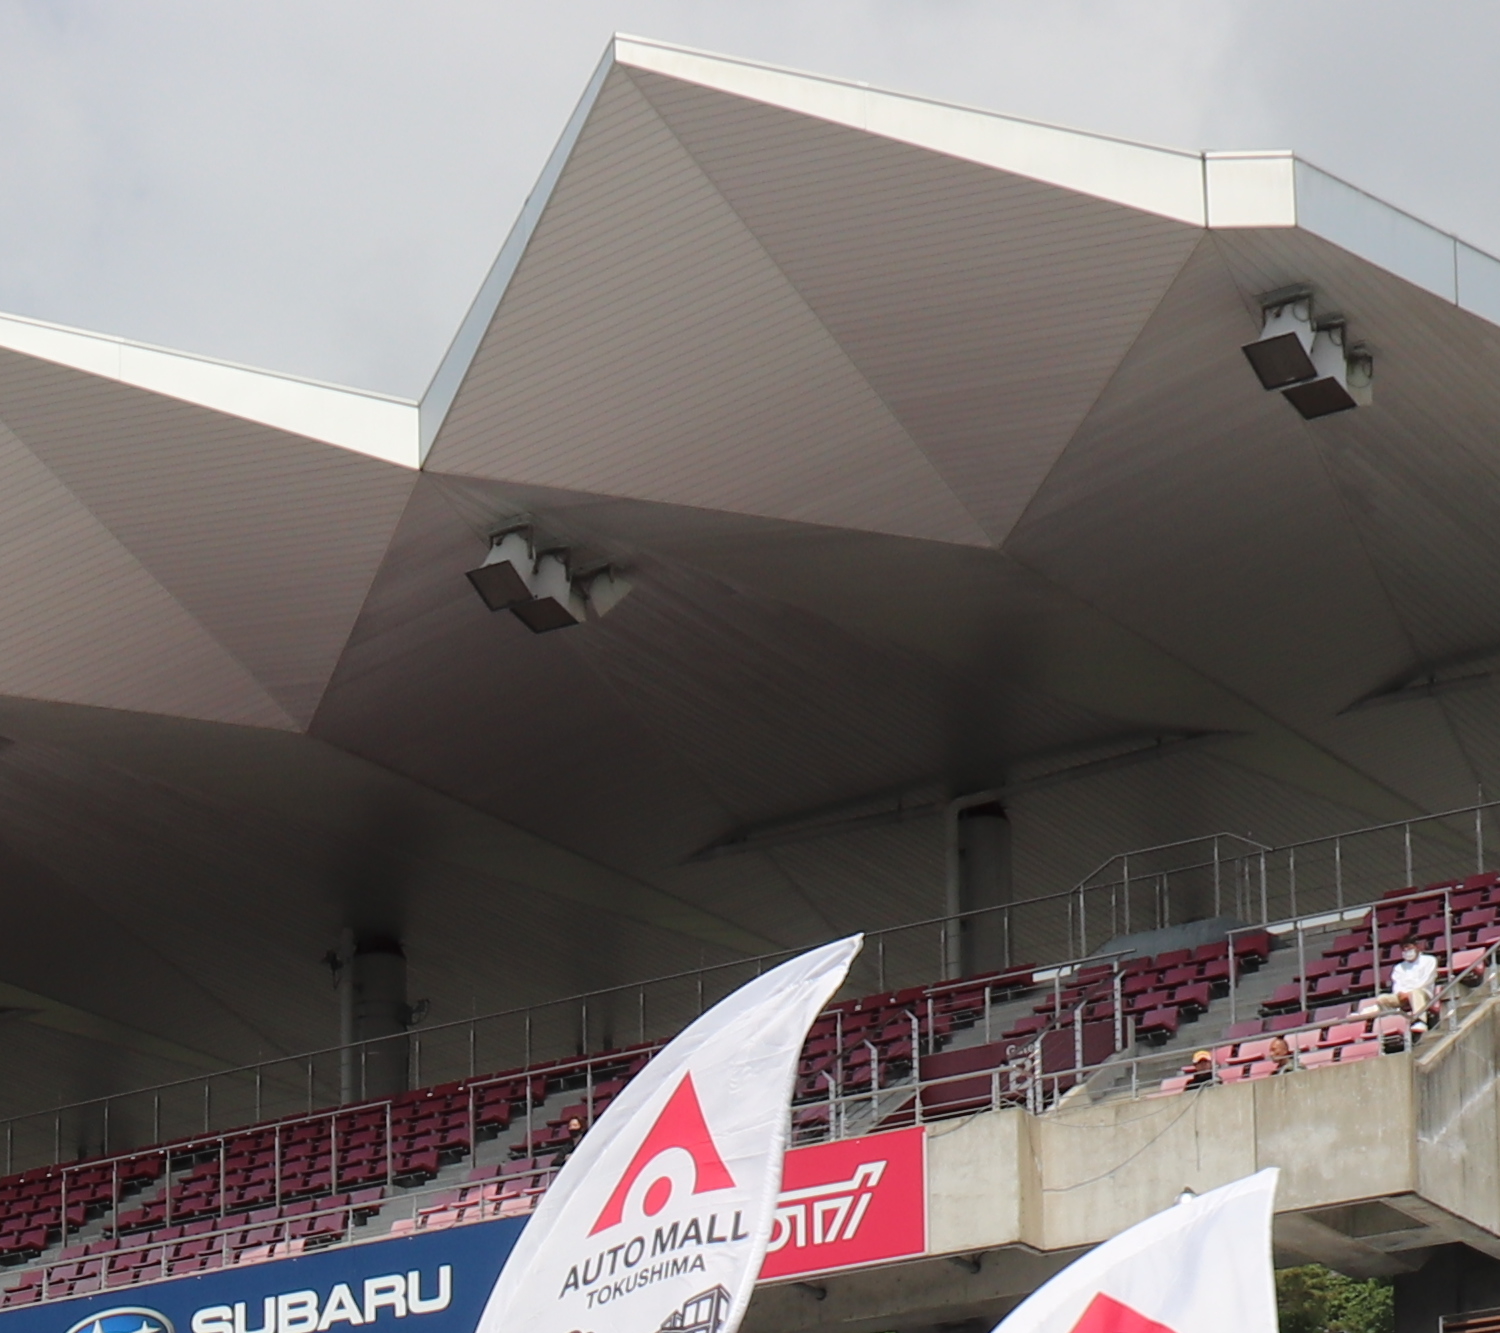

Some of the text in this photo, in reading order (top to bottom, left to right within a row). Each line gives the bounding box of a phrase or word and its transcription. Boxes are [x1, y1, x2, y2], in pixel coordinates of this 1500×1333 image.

[559, 1210, 749, 1299] AUTO MALL
[587, 1254, 705, 1310] TOKUSHIMA
